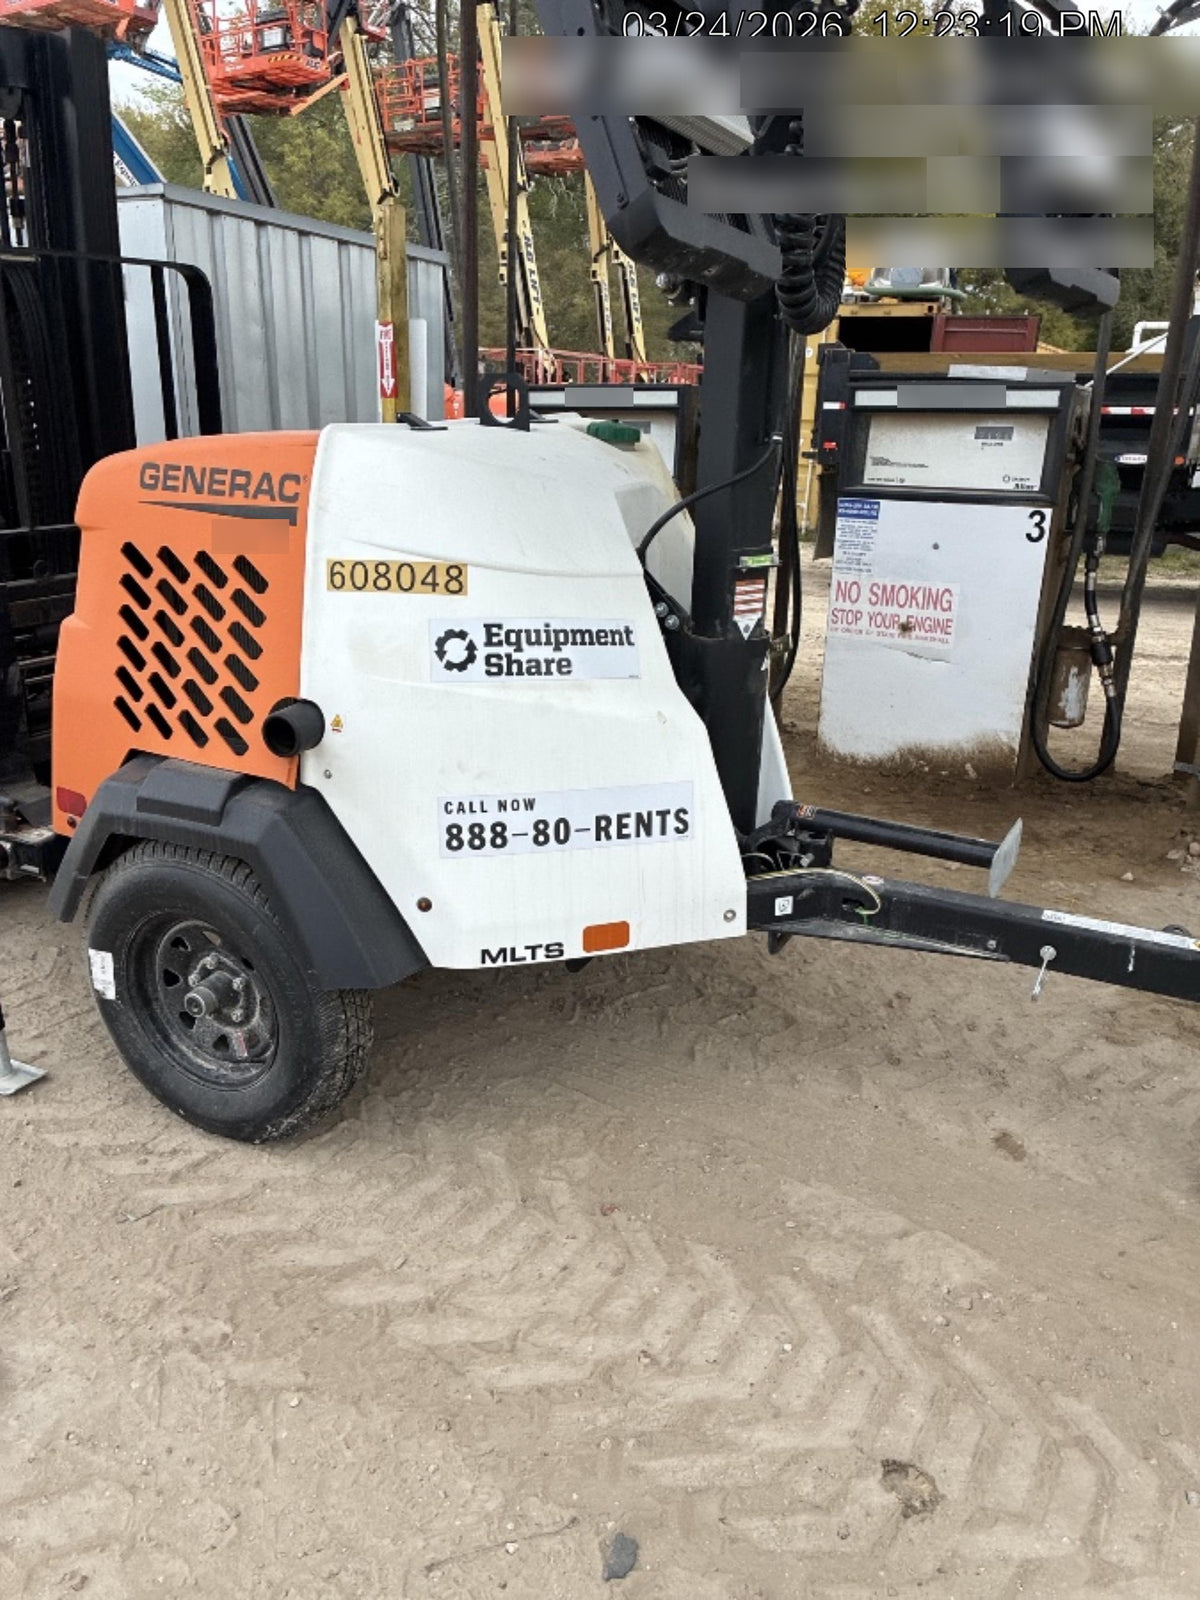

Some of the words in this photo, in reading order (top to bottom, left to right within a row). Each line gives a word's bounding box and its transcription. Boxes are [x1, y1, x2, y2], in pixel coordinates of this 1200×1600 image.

[139, 461, 301, 503] GENERAC
[1025, 510, 1047, 543] 3
[328, 560, 465, 594] 608048
[835, 580, 861, 604] NO
[868, 582, 954, 612] SMOKING
[831, 608, 863, 626] STOP
[867, 611, 902, 630] YOUR
[905, 615, 954, 636] ENGINE
[483, 623, 634, 652] Equipment
[484, 653, 573, 677] Share
[443, 799, 488, 815] CALL
[498, 797, 536, 812] NOW
[445, 807, 690, 852] 888-80-RENTS
[480, 942, 565, 964] MLTS
